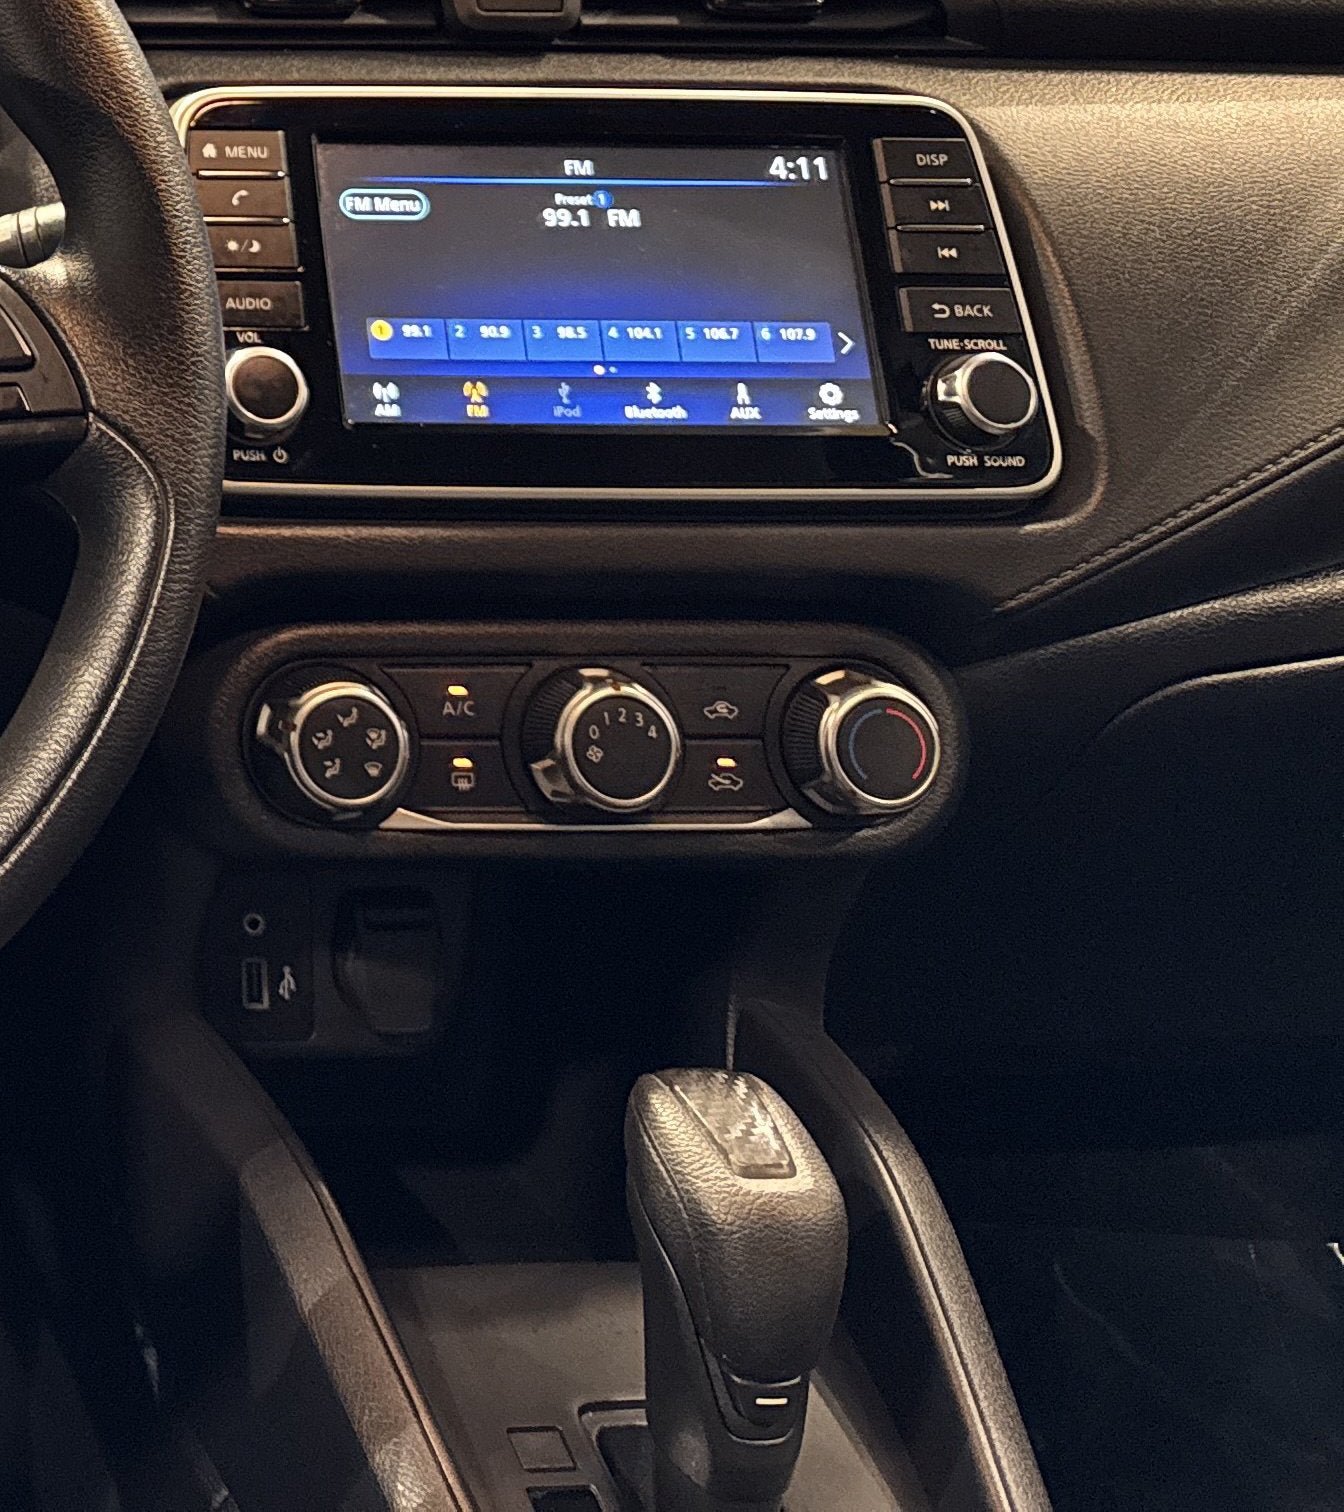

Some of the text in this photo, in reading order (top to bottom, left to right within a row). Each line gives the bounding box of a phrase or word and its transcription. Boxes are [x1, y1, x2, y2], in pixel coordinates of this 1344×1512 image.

[225, 145, 269, 159] MENU
[915, 153, 949, 167] DISP
[563, 159, 595, 176] FM
[768, 155, 828, 181] 4:11
[345, 195, 421, 213] FM Menu
[554, 193, 593, 206] Preset
[542, 208, 642, 228] 99.1 FM
[225, 297, 272, 311] AUDIO
[954, 304, 994, 318] BACK
[236, 331, 262, 343] VOL
[454, 325, 465, 337] 2
[531, 325, 543, 338] 3
[608, 326, 619, 339] 4
[685, 327, 695, 340] 5
[760, 327, 816, 342] 6 107.9
[374, 403, 402, 417] AM
[466, 404, 490, 418] FM
[553, 405, 582, 418] iPod
[624, 405, 688, 419] Bluetooth
[729, 406, 762, 420] AUX
[807, 406, 860, 424] Settings
[232, 449, 265, 462] PUSH
[946, 454, 1026, 468] PUSH SOUND
[442, 701, 475, 718] A/C
[589, 707, 658, 739] 0 1 2 3 4
